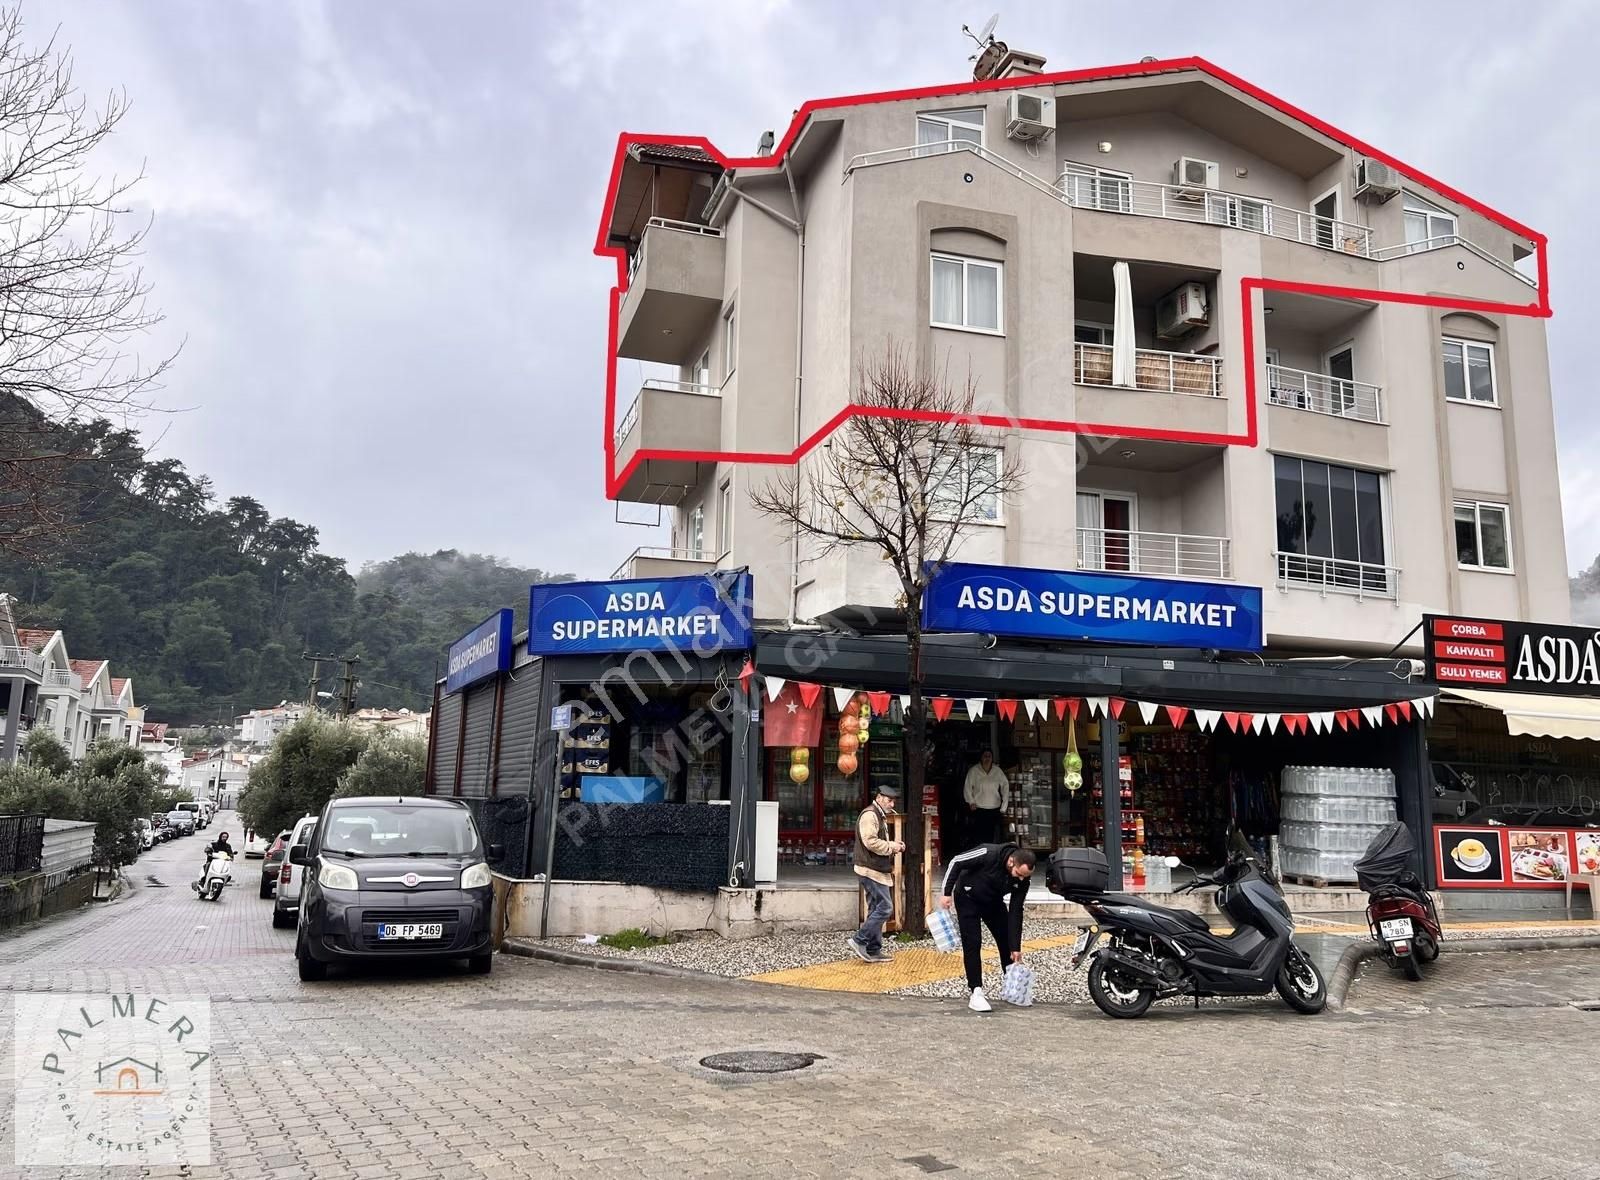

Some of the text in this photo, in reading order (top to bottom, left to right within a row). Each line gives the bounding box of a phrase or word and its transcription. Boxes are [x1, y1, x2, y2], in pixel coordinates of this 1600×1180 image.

[605, 591, 665, 613] ASDA
[957, 584, 1236, 628] ASDA SUPERMARKET
[552, 614, 721, 641] SUPERMARKET
[1451, 624, 1486, 636] ÇORBA
[450, 631, 497, 675] ASDA SUPERMARKET
[1446, 645, 1495, 657] KAHVALTI
[1513, 634, 1600, 685] ASDA
[1440, 667, 1502, 680] SULU YEMEK
[385, 924, 441, 936] 06 FP 5469
[1398, 919, 1410, 927] SN
